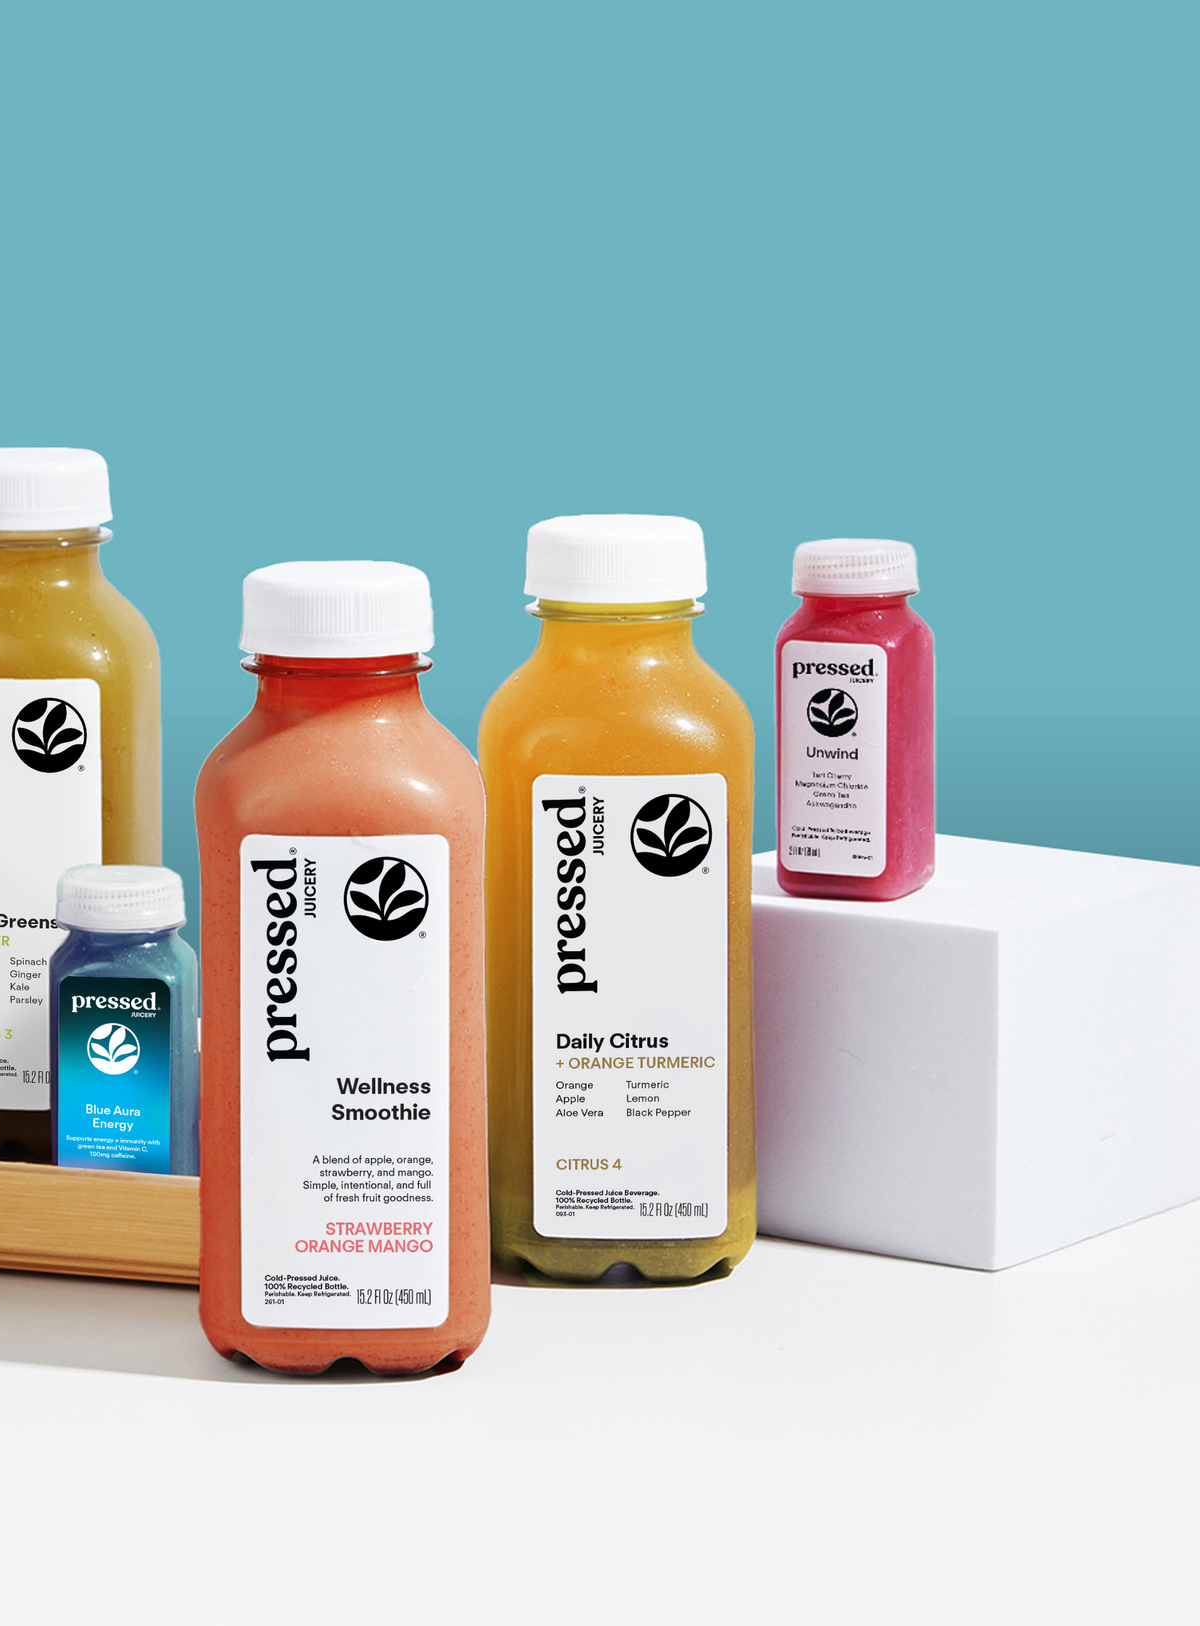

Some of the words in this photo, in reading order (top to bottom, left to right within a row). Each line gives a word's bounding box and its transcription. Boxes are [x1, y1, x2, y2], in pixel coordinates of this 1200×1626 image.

[793, 659, 873, 678] pressed
[807, 747, 858, 760] Unwind
[593, 797, 604, 855] JUICERY
[304, 858, 316, 918] JUICERY
[542, 797, 597, 994] pressed
[251, 858, 310, 1062] pressed
[10, 970, 41, 980] Ginger
[10, 996, 43, 1006] Parsley
[72, 992, 156, 1012] pressed
[5, 1029, 12, 1039] 3
[557, 1033, 604, 1052] Daily
[610, 1033, 668, 1048] Citrus
[569, 1057, 634, 1069] ORANGE
[638, 1056, 715, 1068] TURMERIC
[337, 1078, 430, 1094] Wellness
[556, 1081, 593, 1091] Orange
[86, 1104, 111, 1115] Blue
[113, 1106, 140, 1116] Aura
[332, 1104, 430, 1120] Smoothie
[93, 1118, 134, 1132] Energy
[364, 1155, 394, 1166] apple,
[556, 1159, 608, 1170] CITRUS
[612, 1159, 622, 1170] 4
[320, 1168, 374, 1178] strawberry,
[303, 1180, 338, 1191] Simple,
[383, 1193, 433, 1204] goodness.
[326, 1222, 432, 1235] STRAWBERRY
[295, 1240, 364, 1252] ORANGE
[369, 1240, 433, 1252] MANGO
